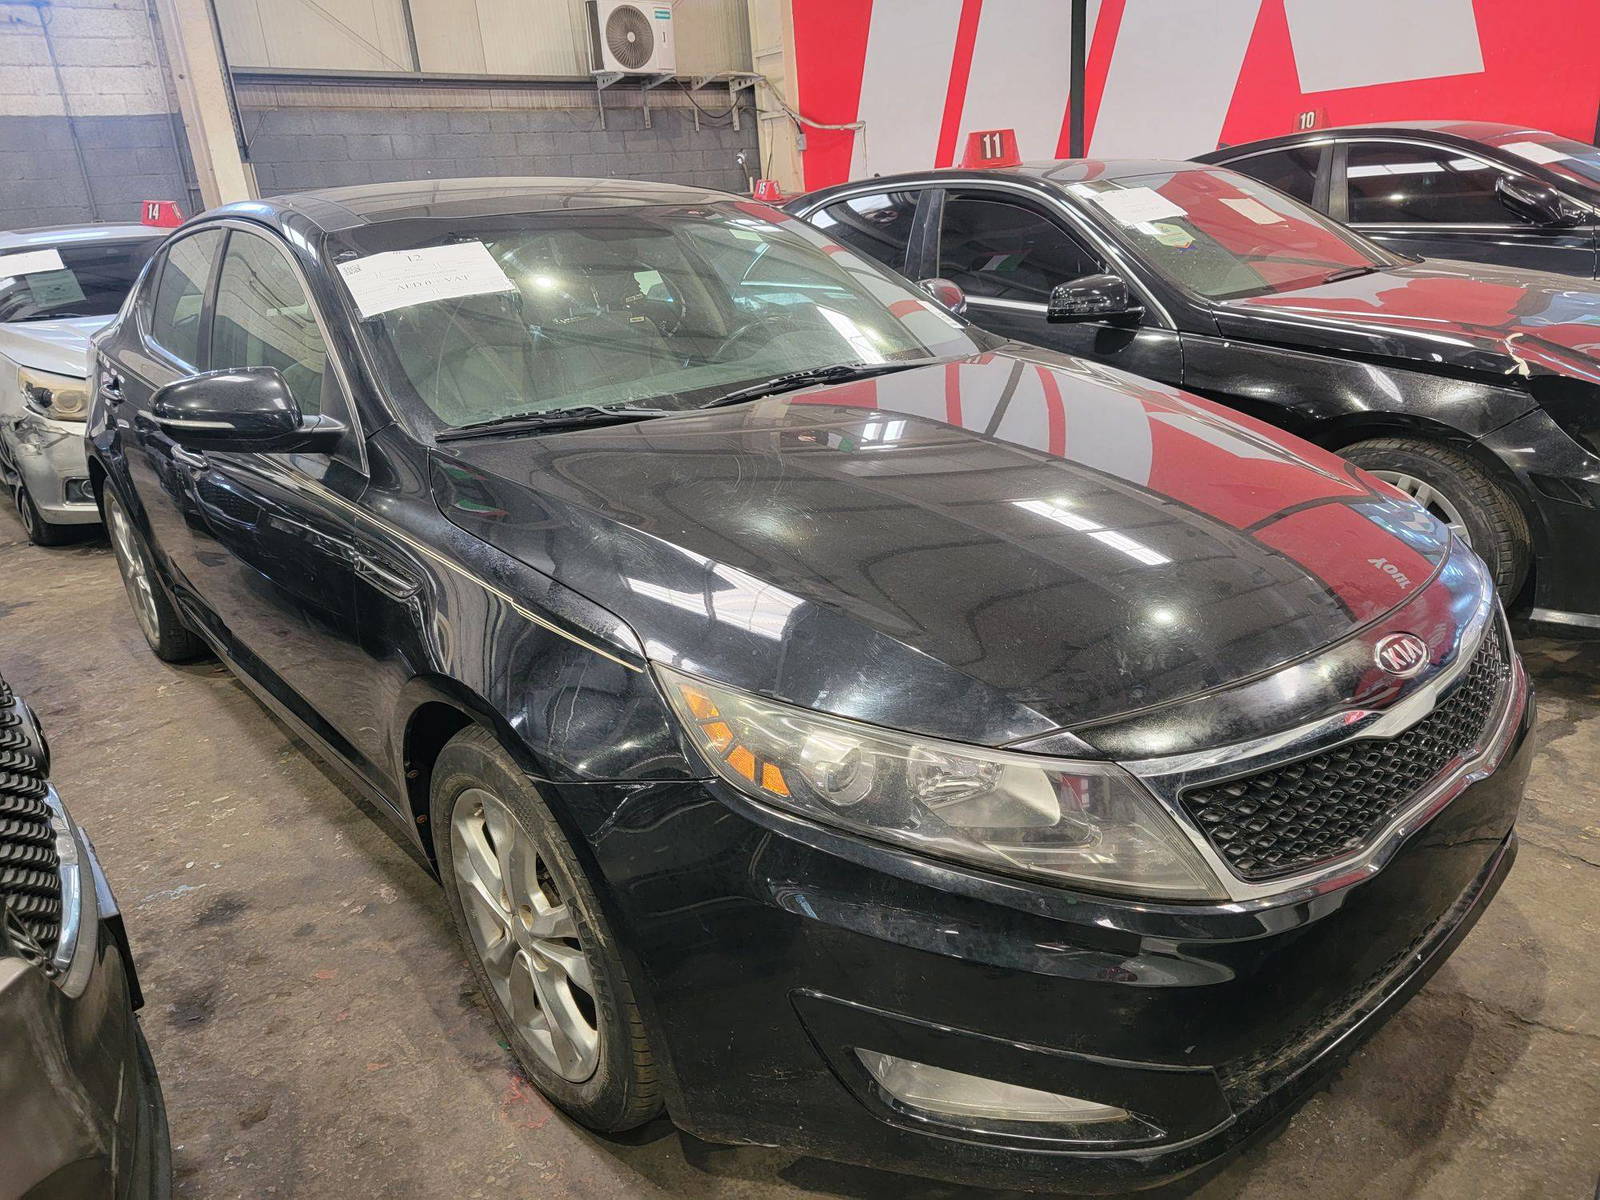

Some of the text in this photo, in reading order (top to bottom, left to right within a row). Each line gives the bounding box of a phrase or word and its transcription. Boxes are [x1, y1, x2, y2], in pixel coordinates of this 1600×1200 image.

[1300, 111, 1315, 129] 10
[983, 133, 1001, 159] 11
[758, 182, 767, 195] 15
[148, 203, 160, 220] 14
[406, 254, 424, 263] 12
[1381, 639, 1422, 670] KIA
